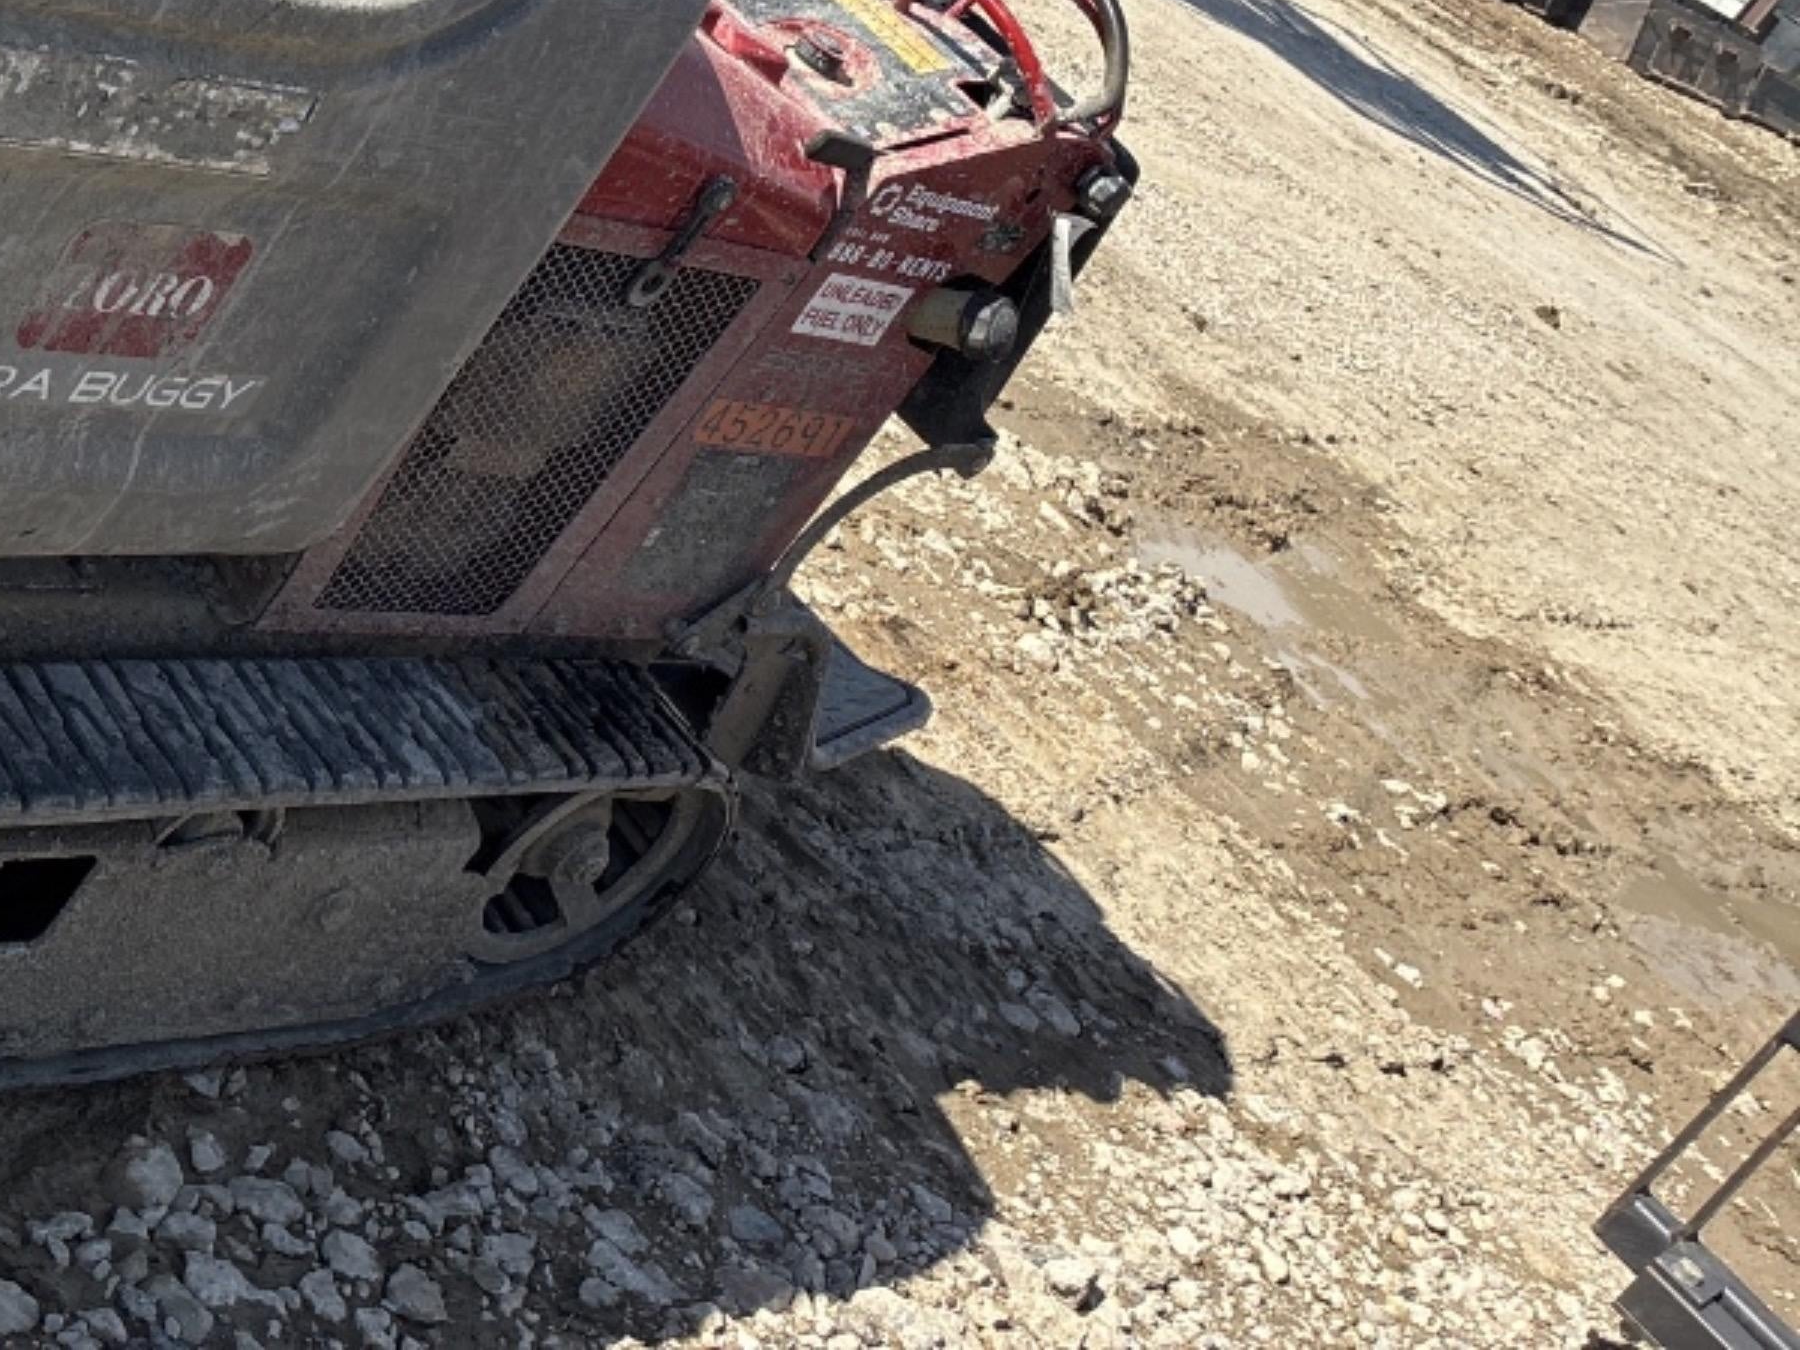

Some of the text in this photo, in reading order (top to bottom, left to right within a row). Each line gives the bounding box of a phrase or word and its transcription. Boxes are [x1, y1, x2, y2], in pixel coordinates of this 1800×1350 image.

[887, 206, 940, 232] Share
[905, 183, 999, 221] Equipment
[827, 241, 951, 283] 888-80-RENTS
[803, 308, 886, 337] FUEL ONLY
[68, 371, 256, 410] BUGGY
